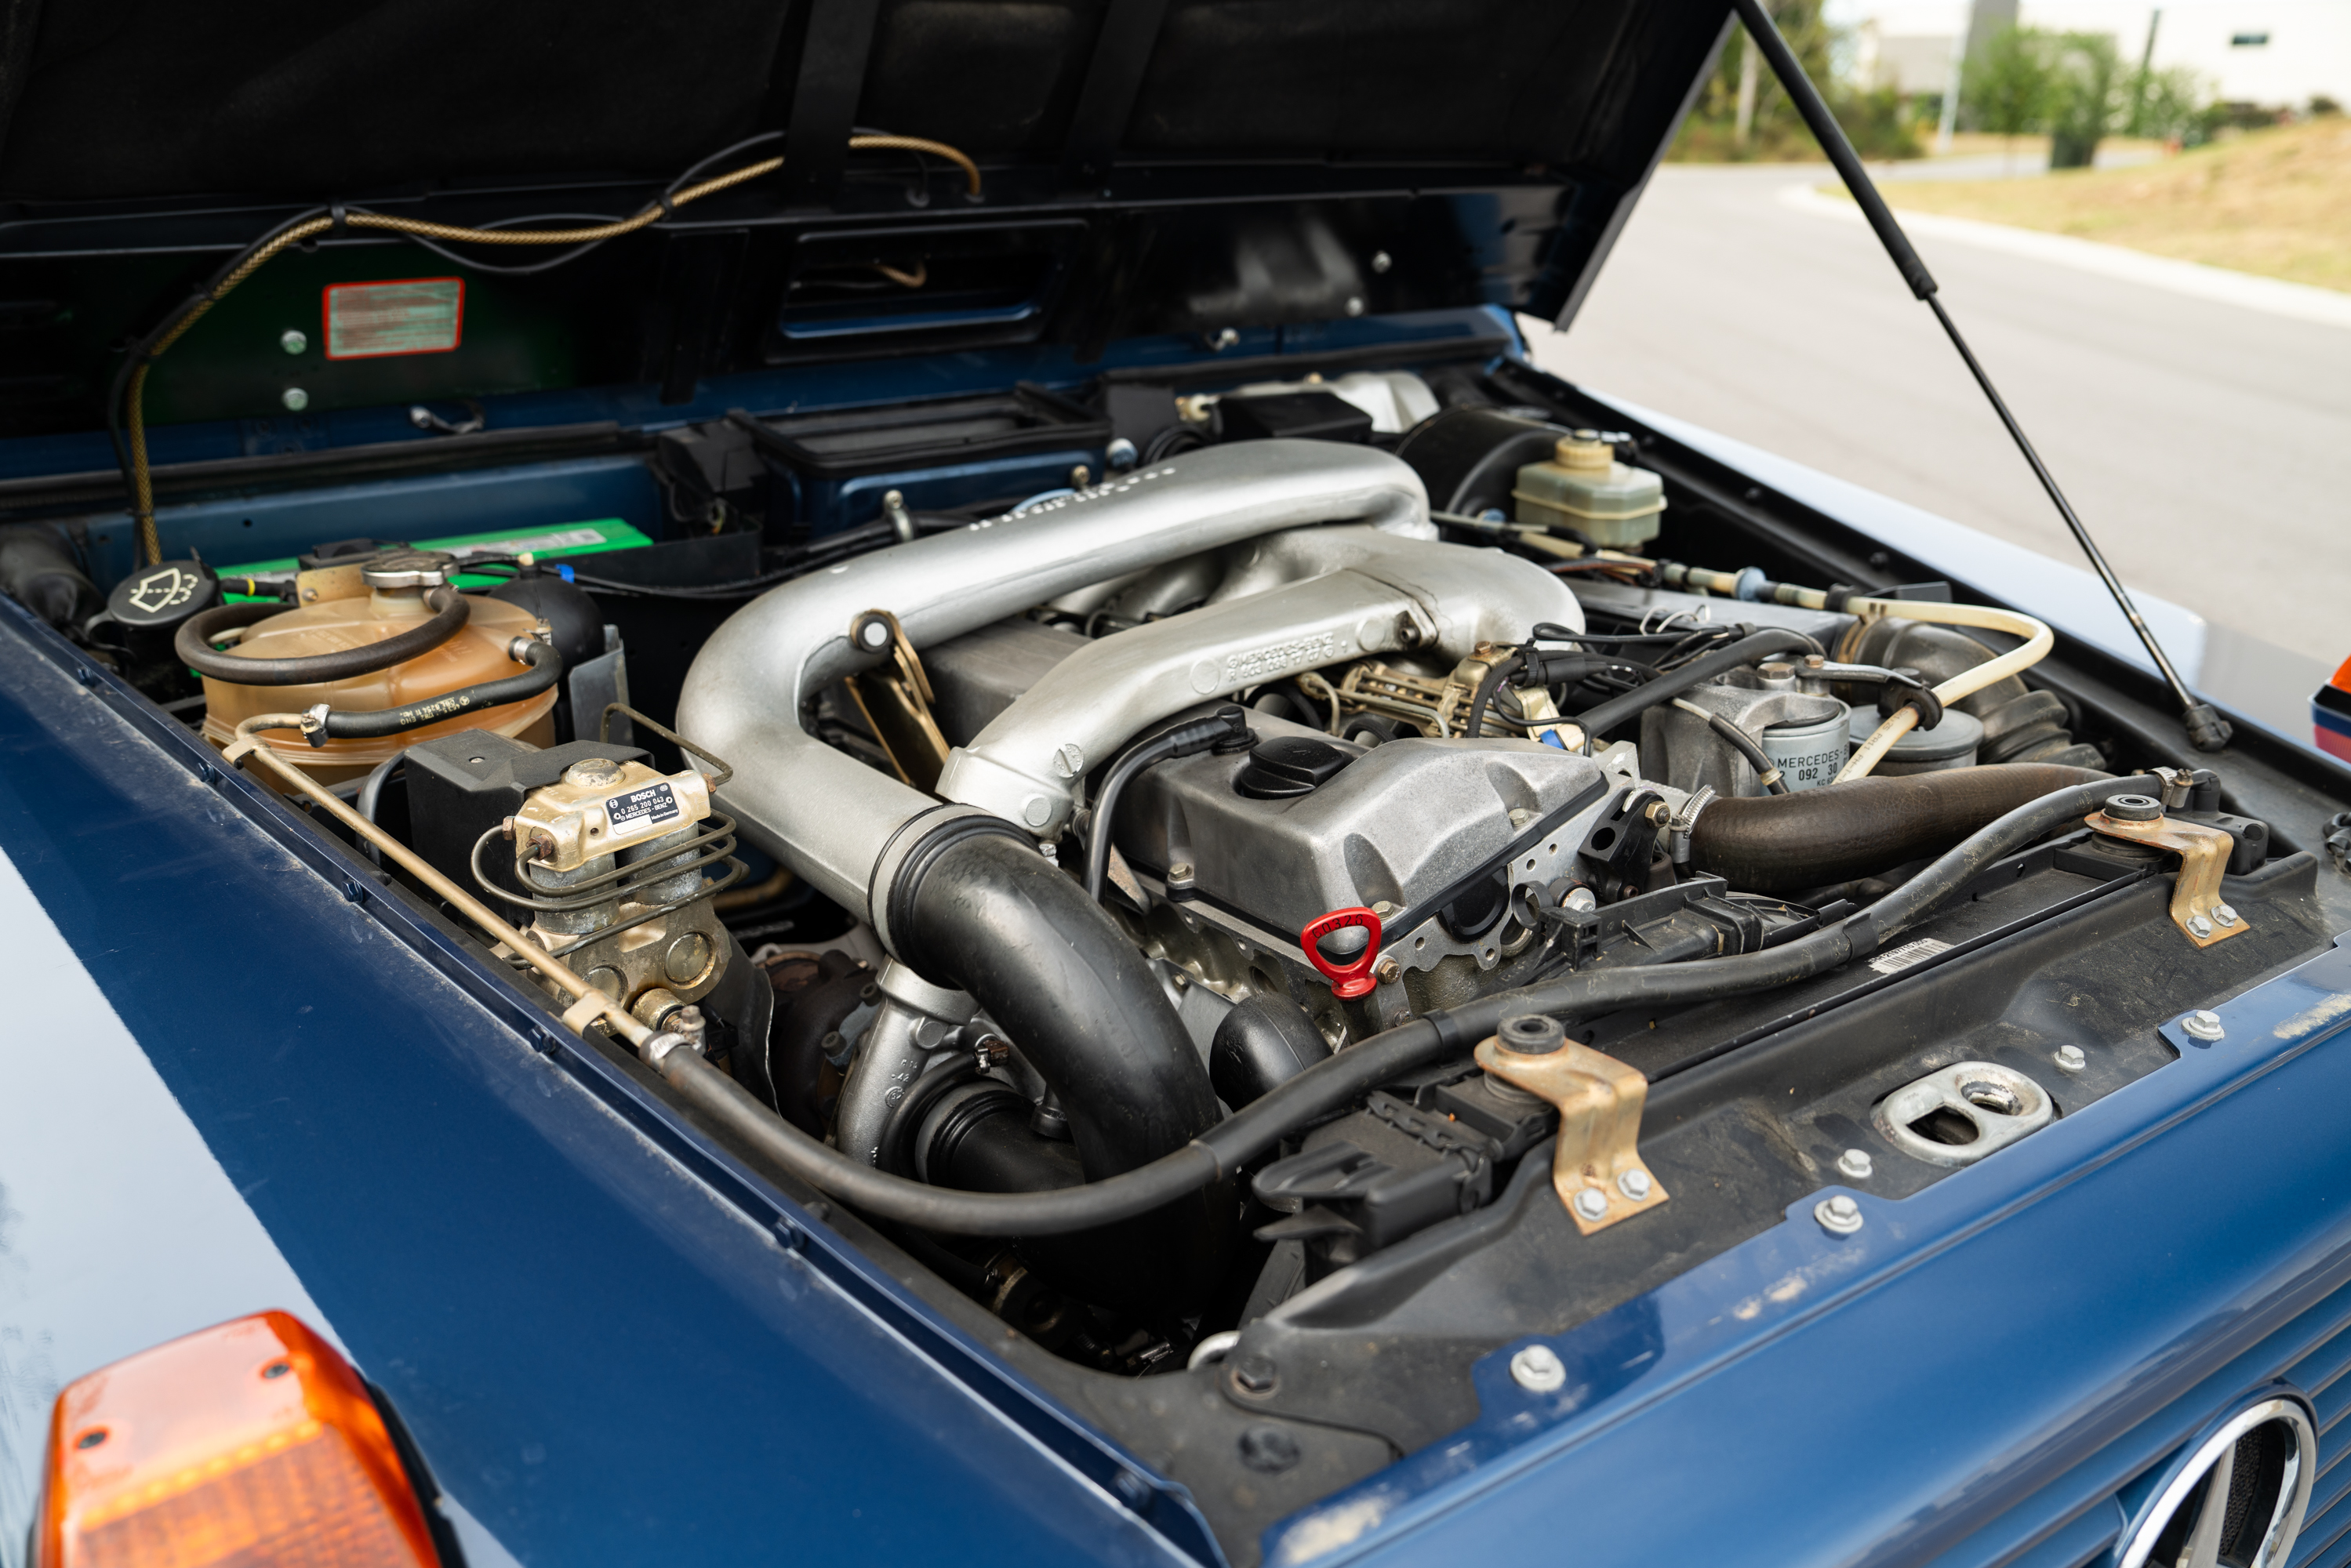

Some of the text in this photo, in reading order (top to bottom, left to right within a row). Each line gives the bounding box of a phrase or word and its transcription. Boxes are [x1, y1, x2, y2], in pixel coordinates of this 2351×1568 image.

[1798, 768, 1819, 781] 092
[1827, 762, 1837, 775] 30
[627, 804, 639, 813] 265
[640, 800, 652, 809] 200
[652, 796, 664, 804] 043
[630, 789, 656, 803] BOSCH
